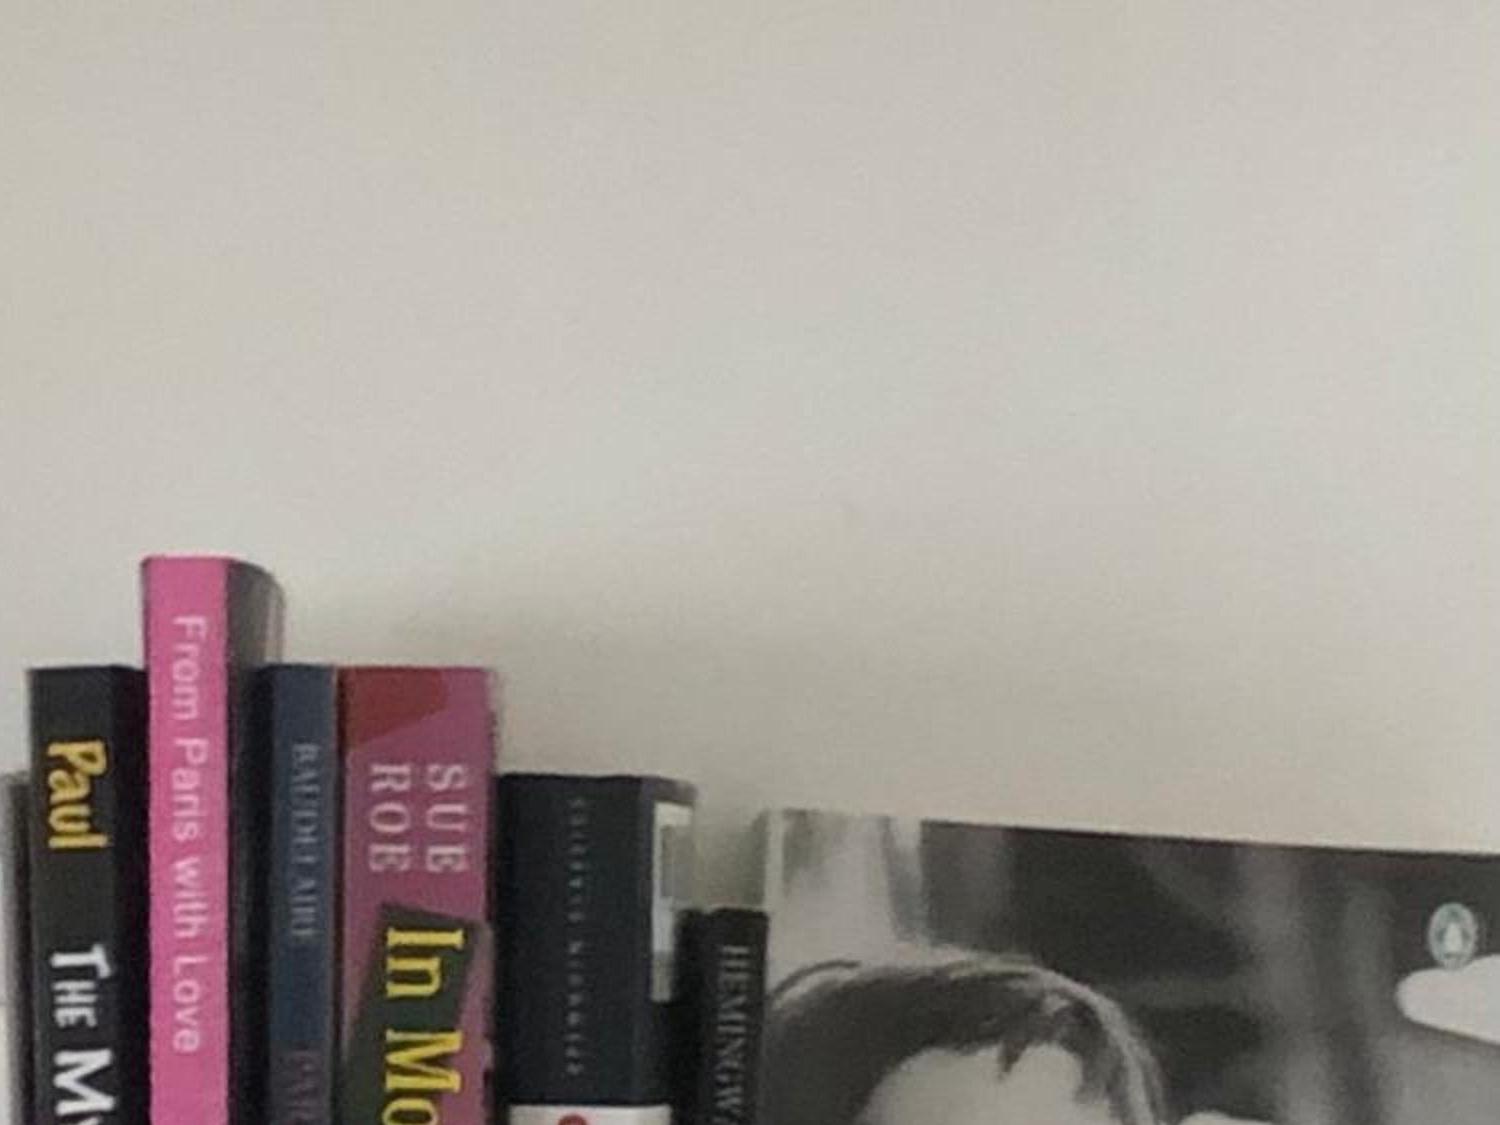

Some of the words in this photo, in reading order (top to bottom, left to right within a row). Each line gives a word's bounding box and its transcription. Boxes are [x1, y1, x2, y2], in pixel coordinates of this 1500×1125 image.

[170, 614, 208, 721] From
[46, 738, 116, 849] Paul
[171, 737, 210, 843] Paris
[367, 763, 412, 873] ROE
[425, 763, 469, 873] SUE
[173, 855, 210, 938] with
[173, 953, 210, 1054] Love
[384, 926, 465, 999] In
